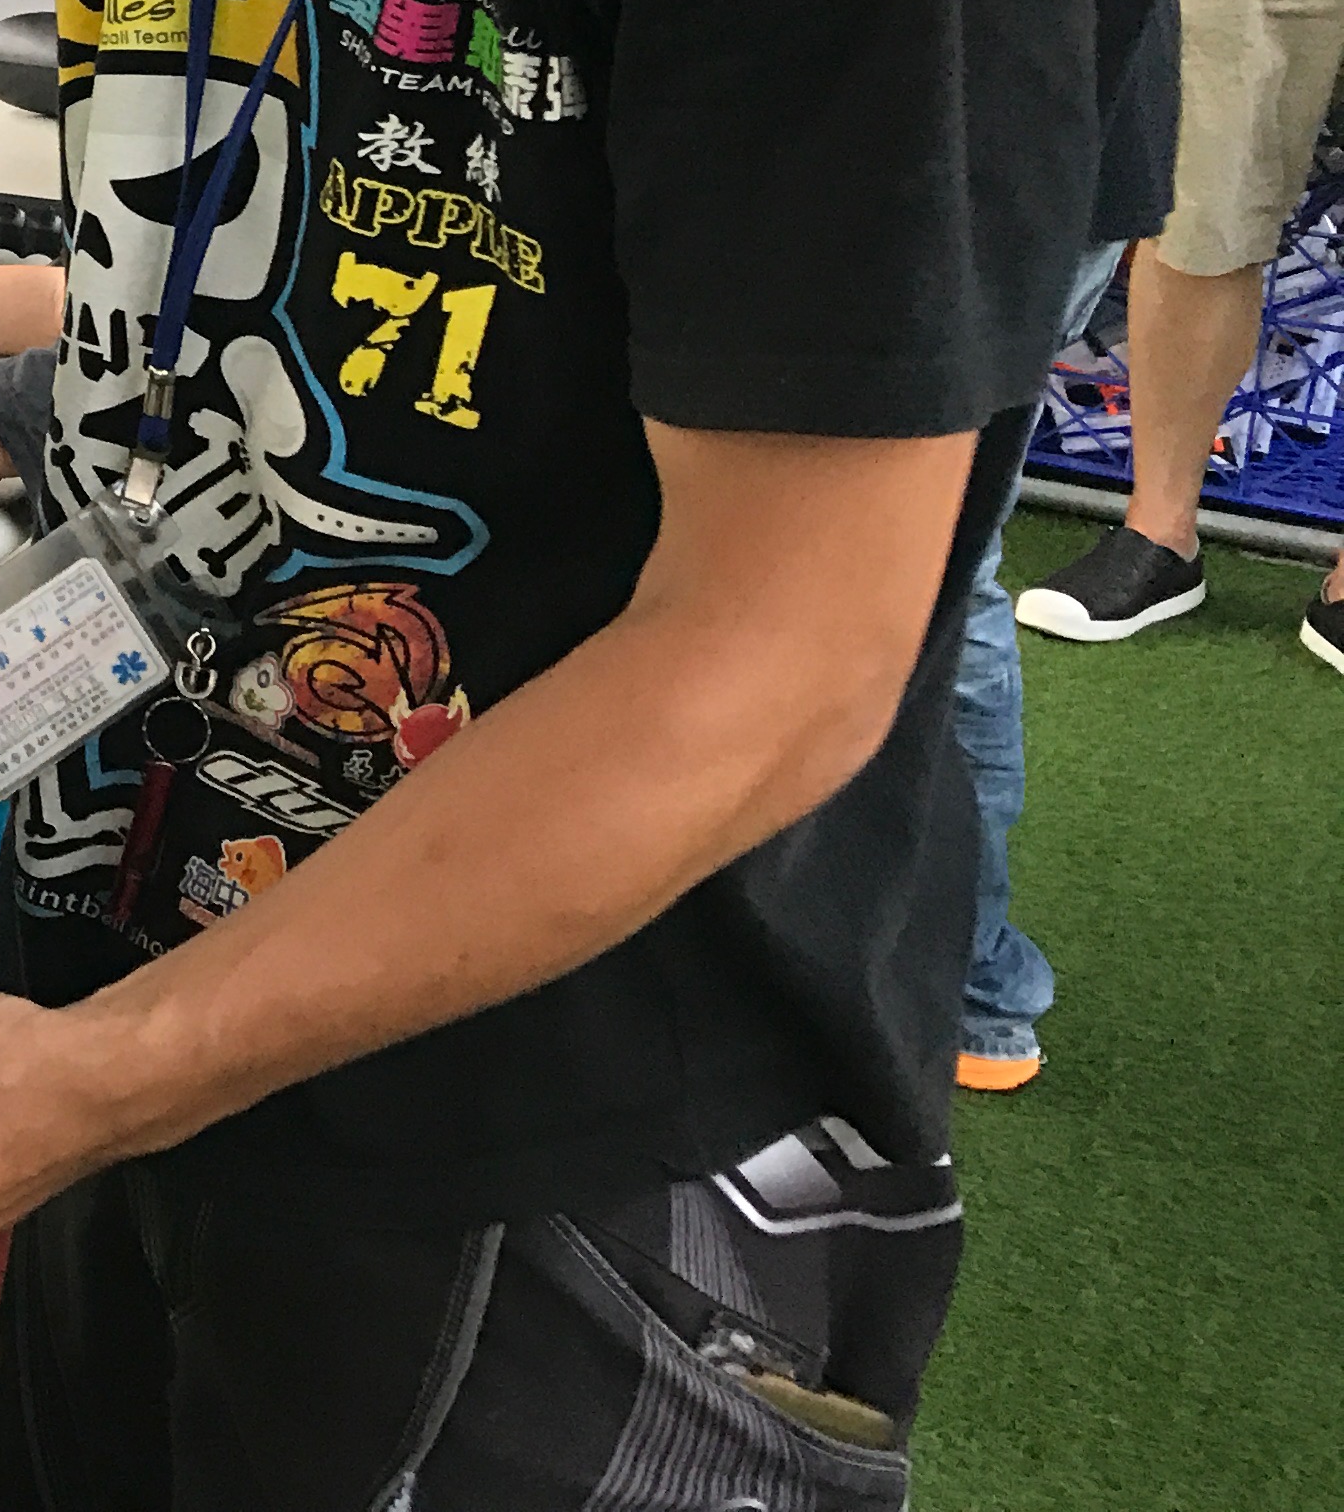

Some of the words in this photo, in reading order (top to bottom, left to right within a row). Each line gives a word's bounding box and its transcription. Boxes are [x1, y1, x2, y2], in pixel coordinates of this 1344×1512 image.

[134, 29, 190, 45] Team
[319, 157, 546, 294] APPLE
[331, 251, 497, 429] 71
